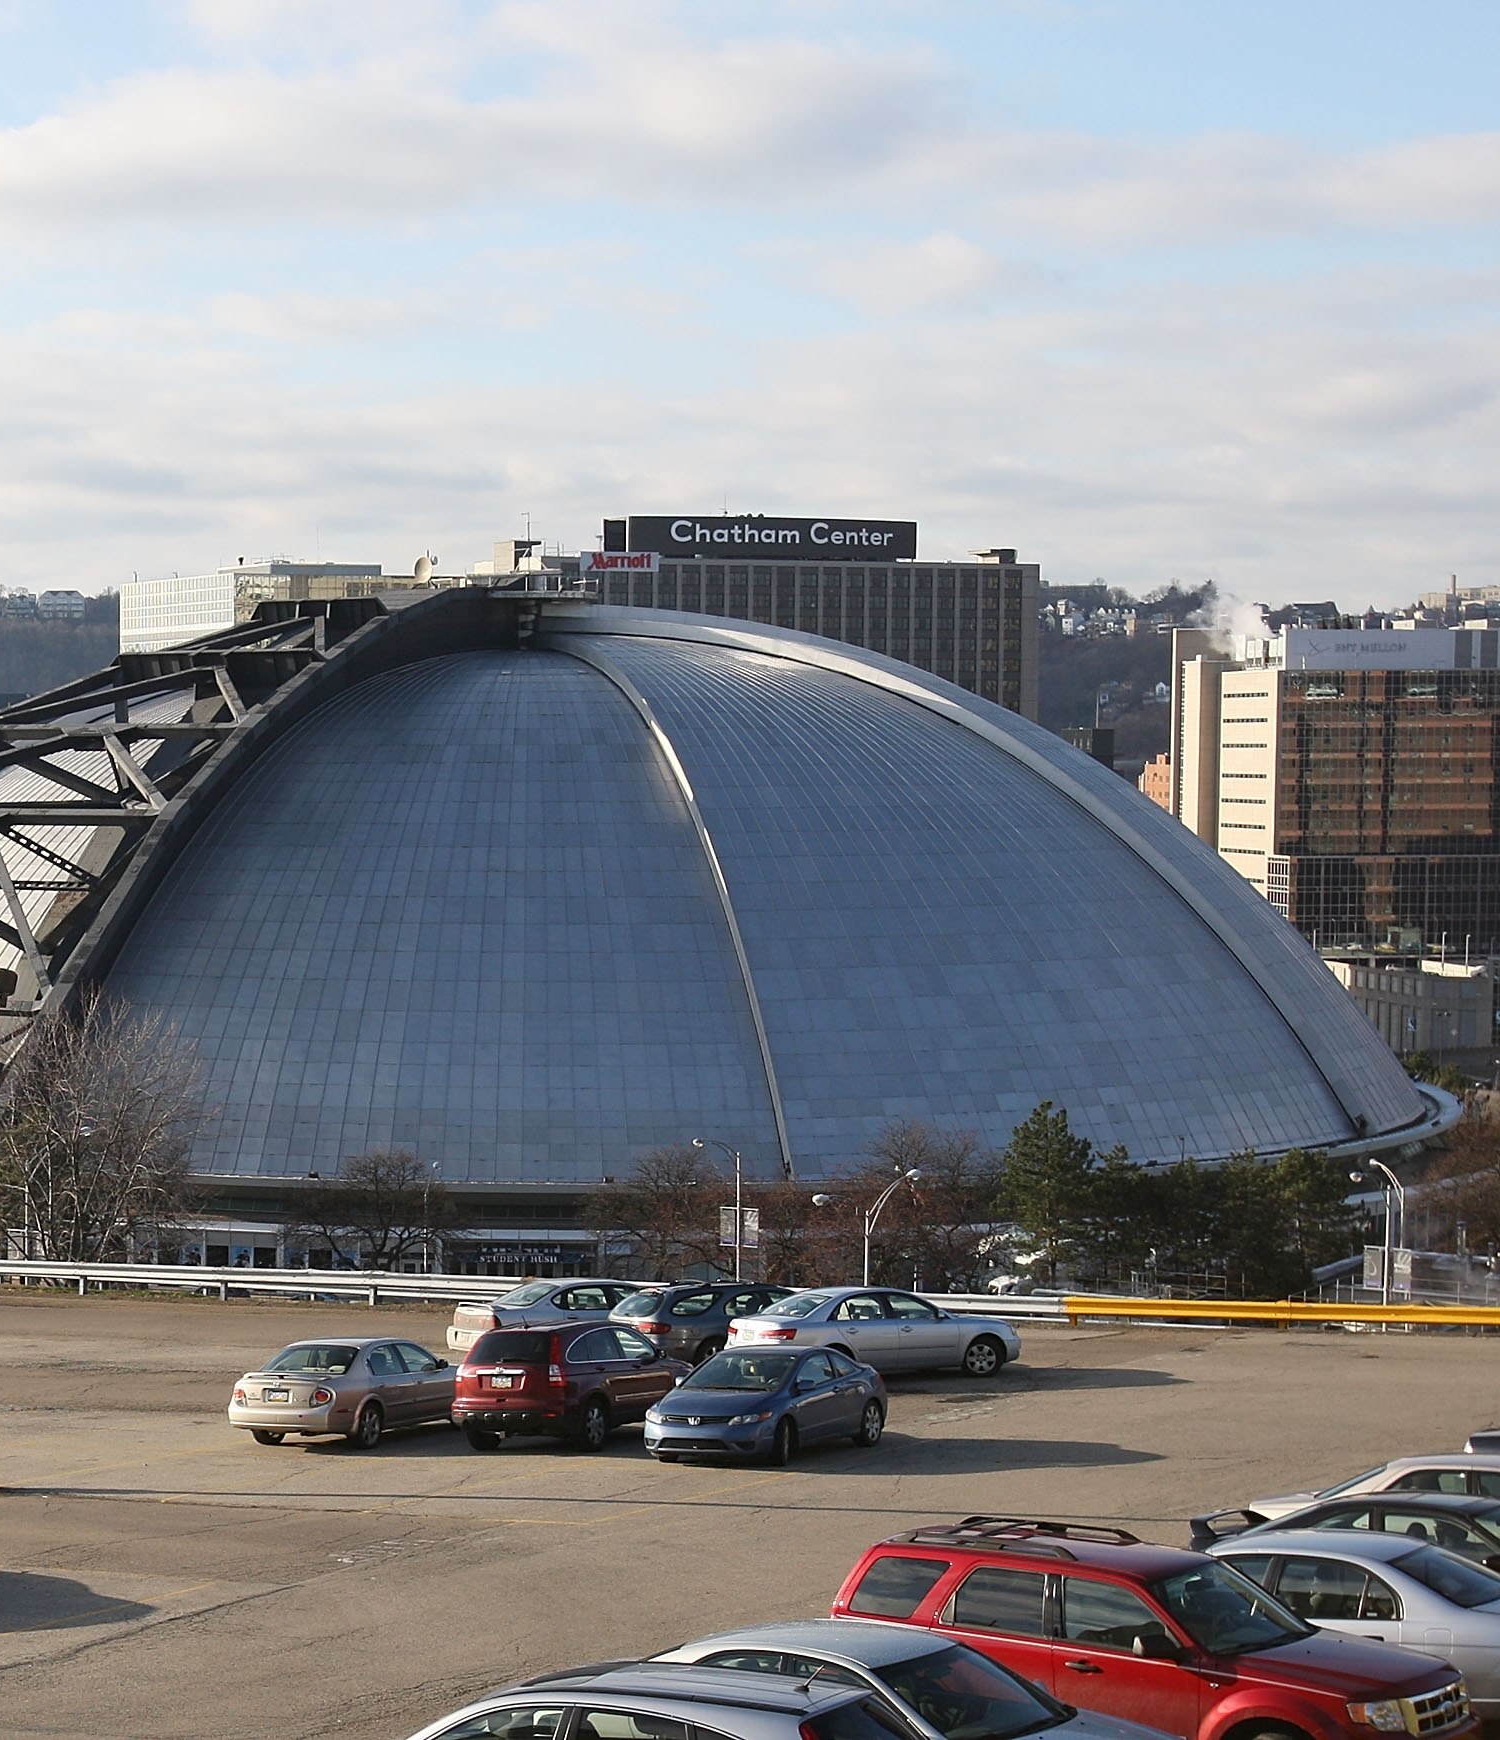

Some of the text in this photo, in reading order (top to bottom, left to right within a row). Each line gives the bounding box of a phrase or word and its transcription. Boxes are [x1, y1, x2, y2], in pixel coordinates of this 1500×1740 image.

[670, 519, 894, 546] Chatham Center
[587, 552, 651, 570] Marriott
[480, 1255, 558, 1264] STUDENT RUSH
